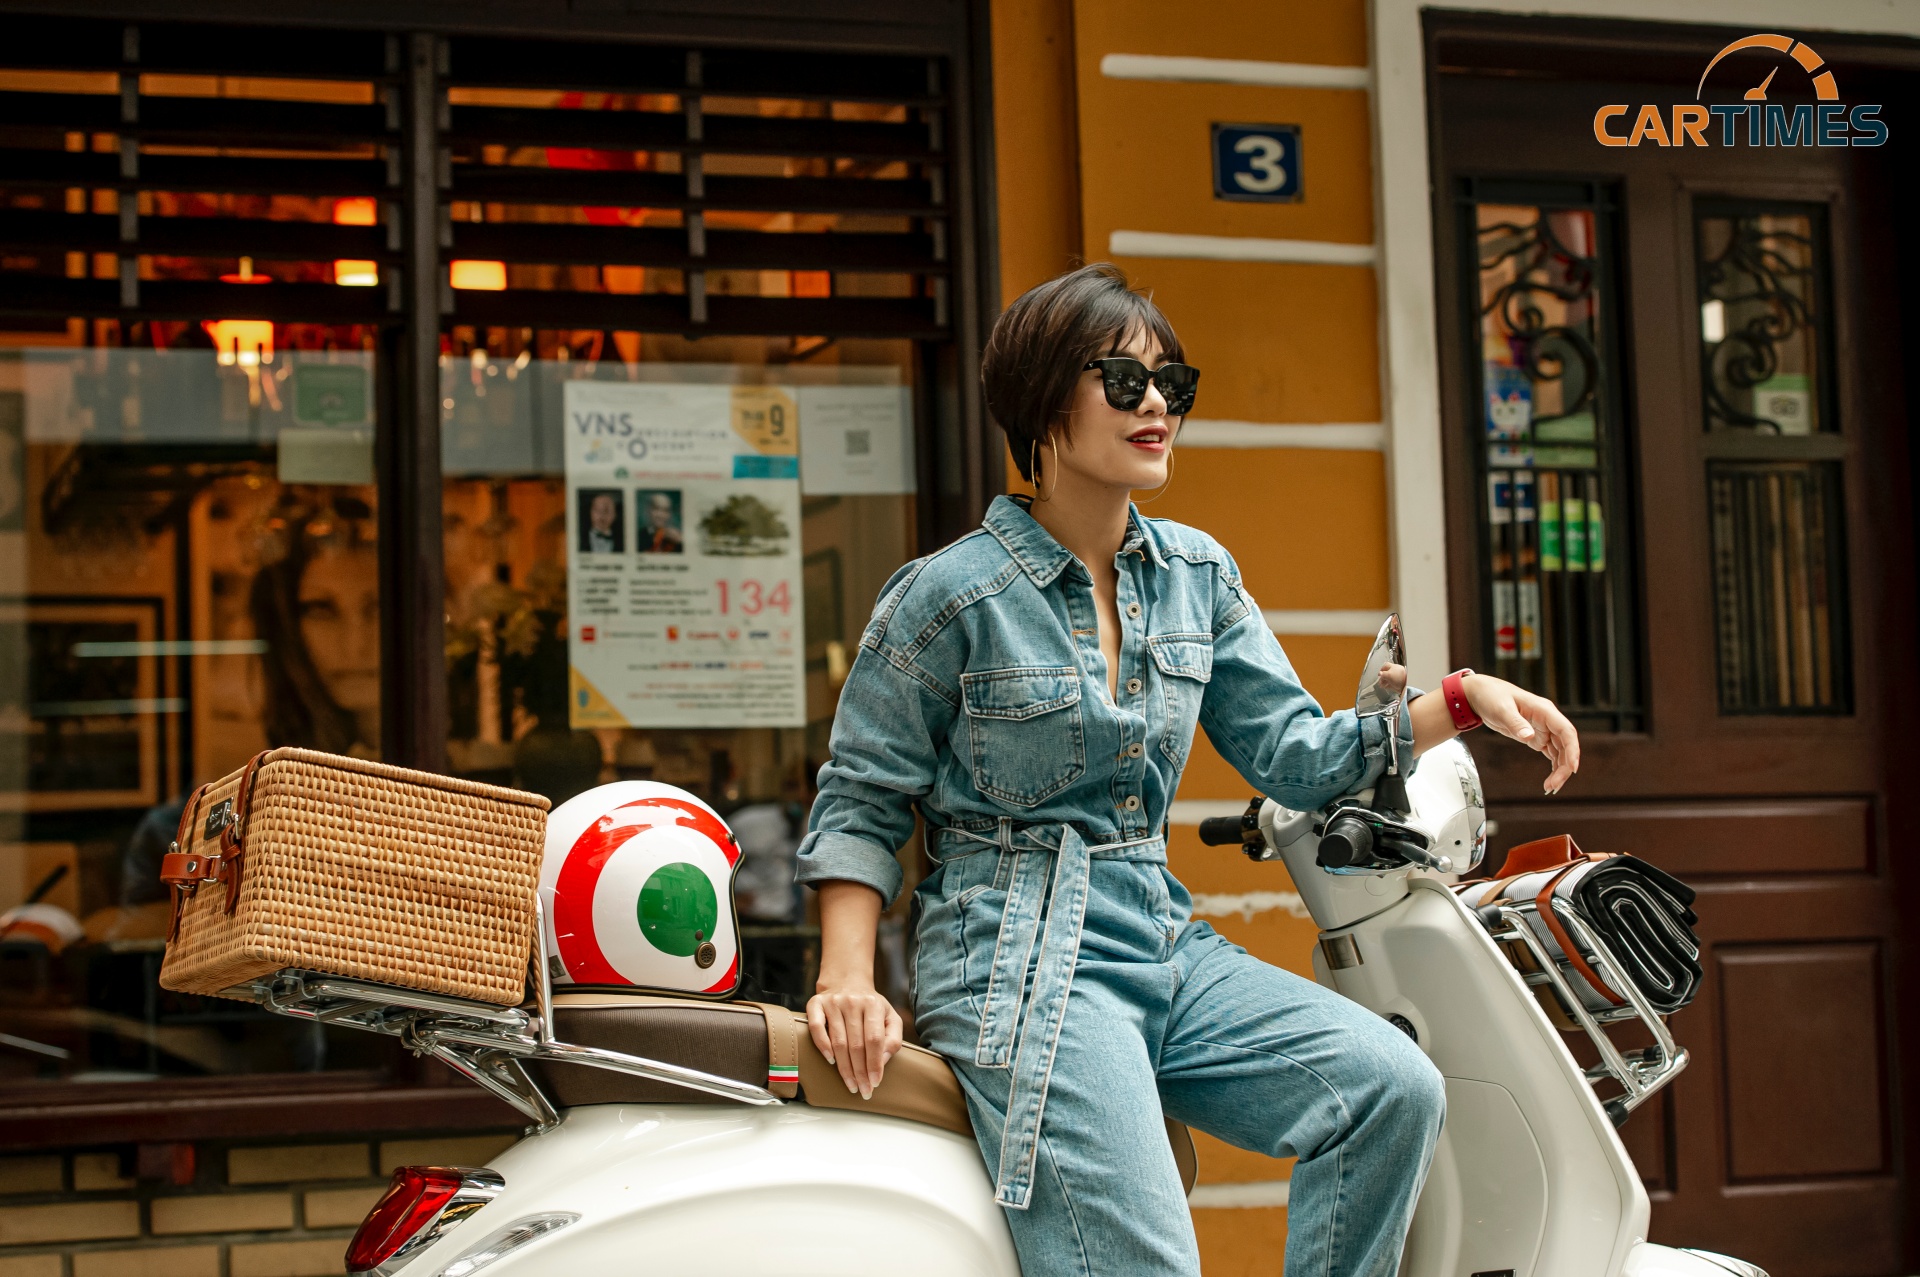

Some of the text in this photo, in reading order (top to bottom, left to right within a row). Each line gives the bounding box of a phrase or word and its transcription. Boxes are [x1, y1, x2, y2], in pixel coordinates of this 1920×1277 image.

[1233, 134, 1287, 193] 3
[769, 403, 785, 437] 9
[714, 579, 792, 616] 134
